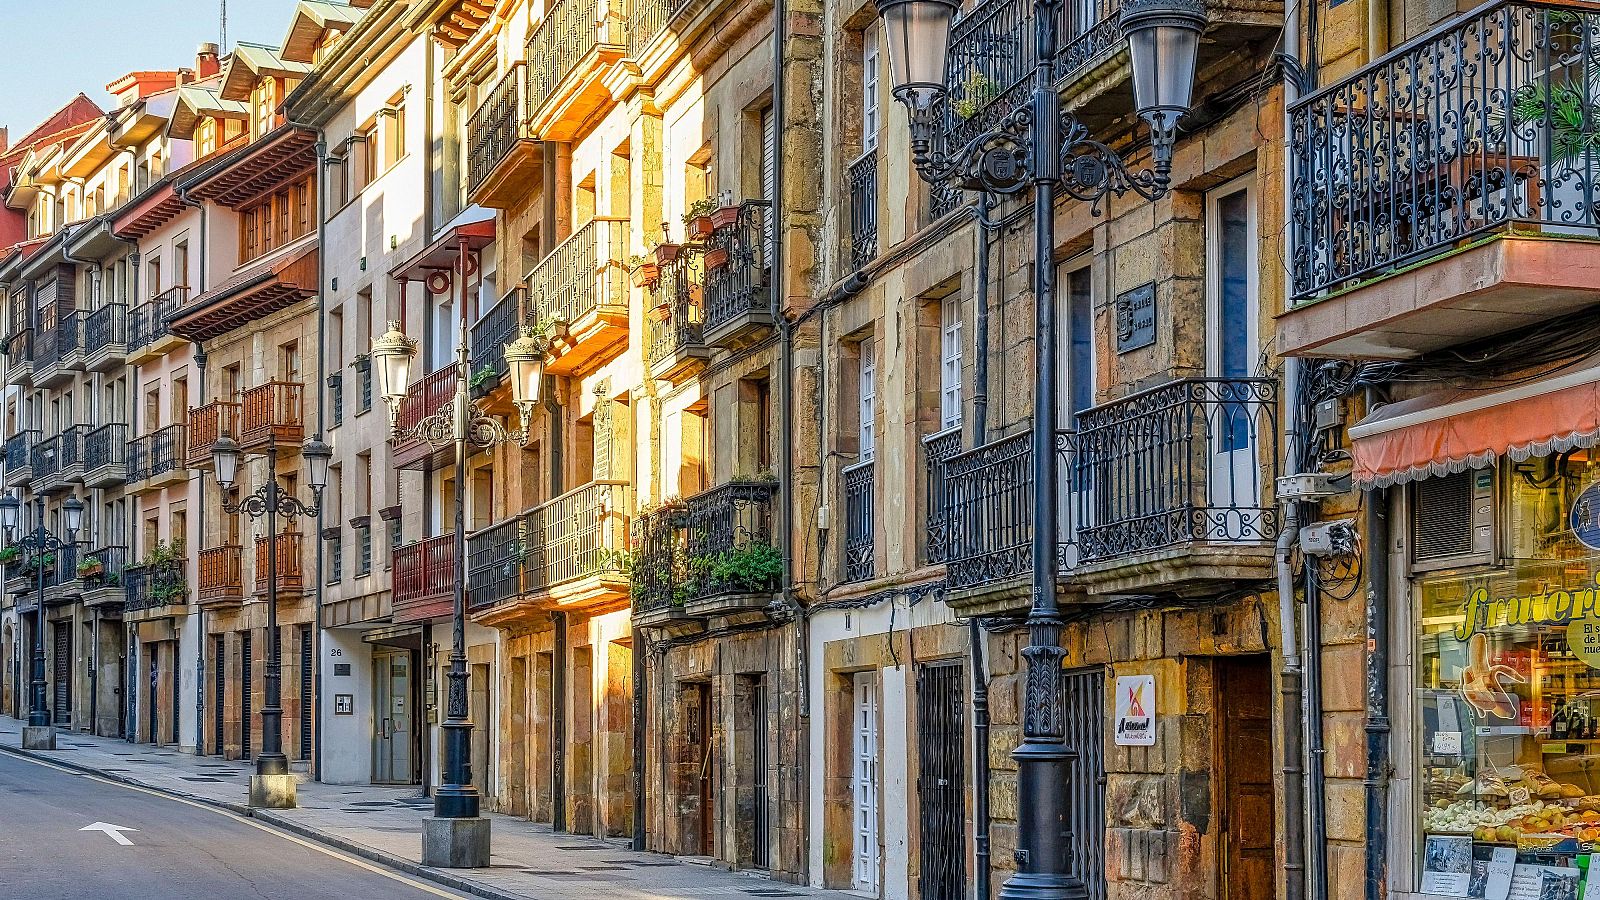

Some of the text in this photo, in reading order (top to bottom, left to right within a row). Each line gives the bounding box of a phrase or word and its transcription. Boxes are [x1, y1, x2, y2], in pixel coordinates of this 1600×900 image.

[1584, 623, 1593, 634] El
[1584, 634, 1596, 644] de
[331, 649, 342, 657] 26
